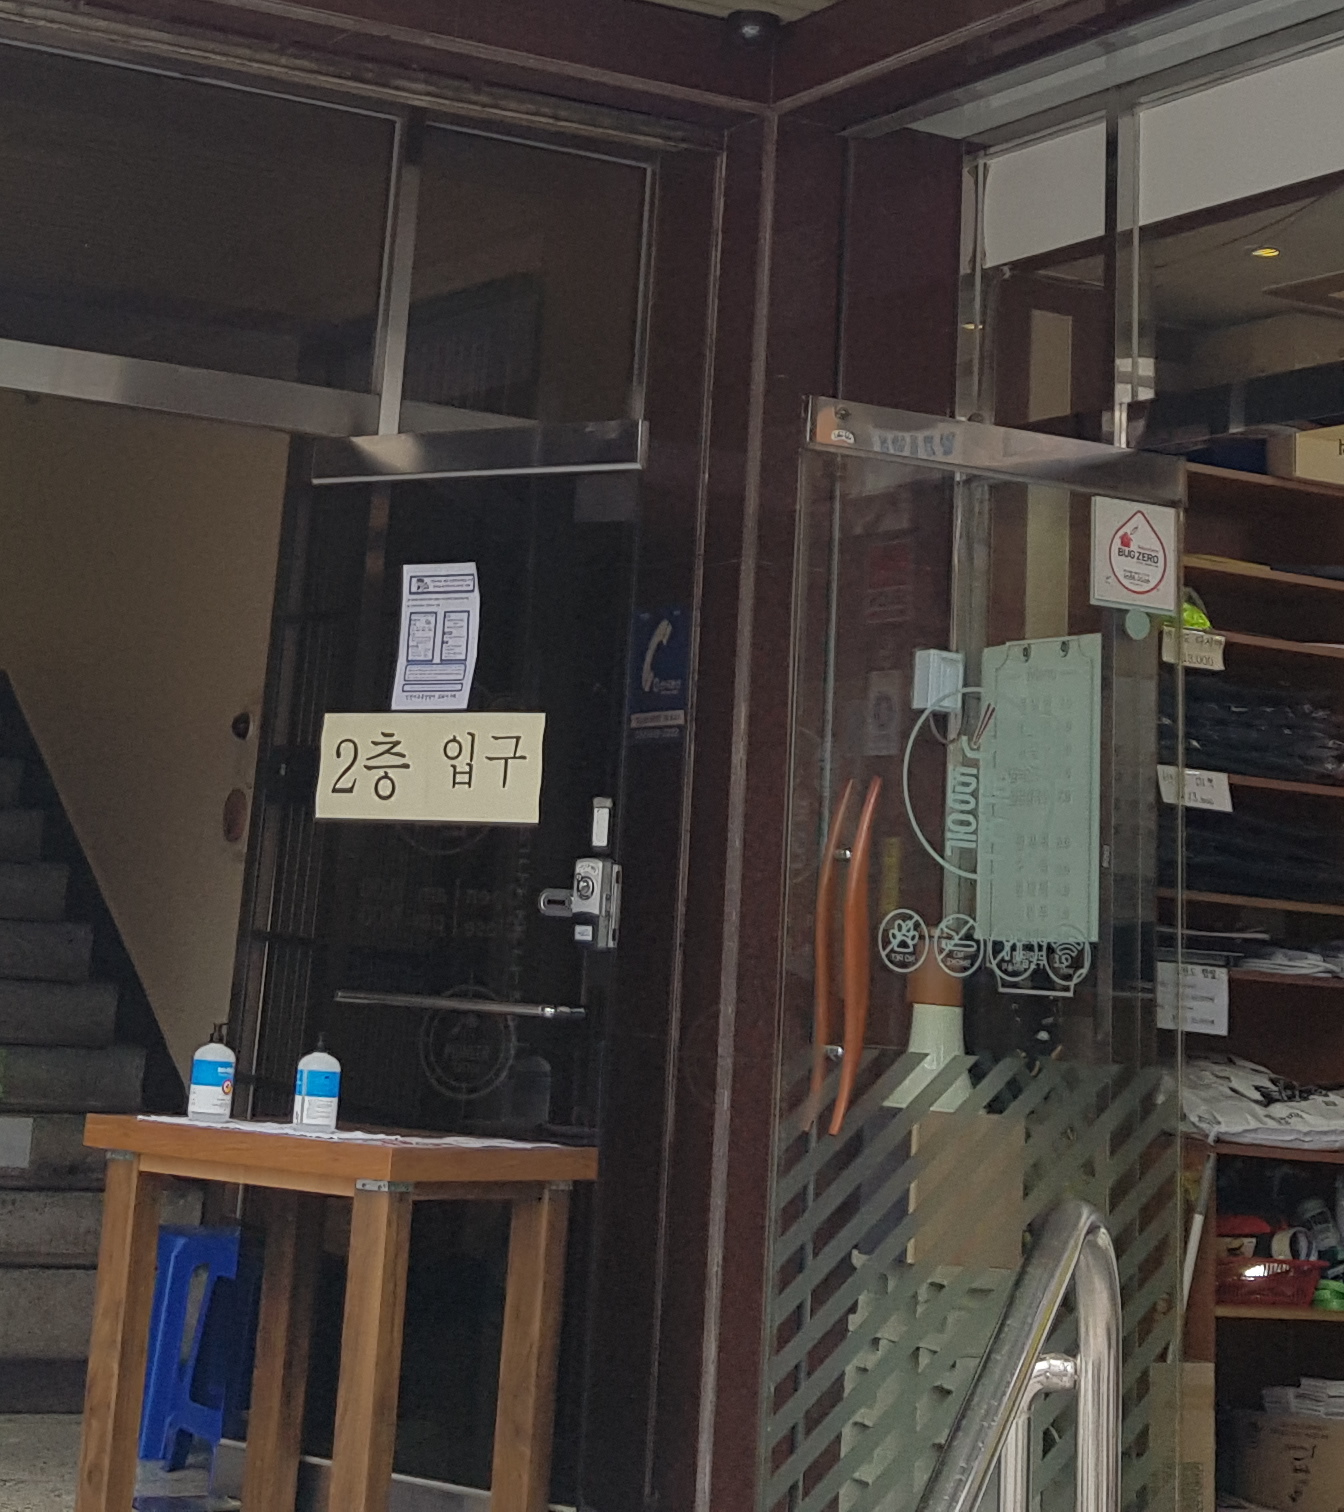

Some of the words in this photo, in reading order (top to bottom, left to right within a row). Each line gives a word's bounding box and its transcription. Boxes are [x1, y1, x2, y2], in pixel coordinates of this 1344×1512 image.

[1118, 548, 1135, 559] BUG
[1137, 551, 1159, 564] ZERO
[331, 732, 411, 800] 2층
[442, 730, 528, 789] 입구
